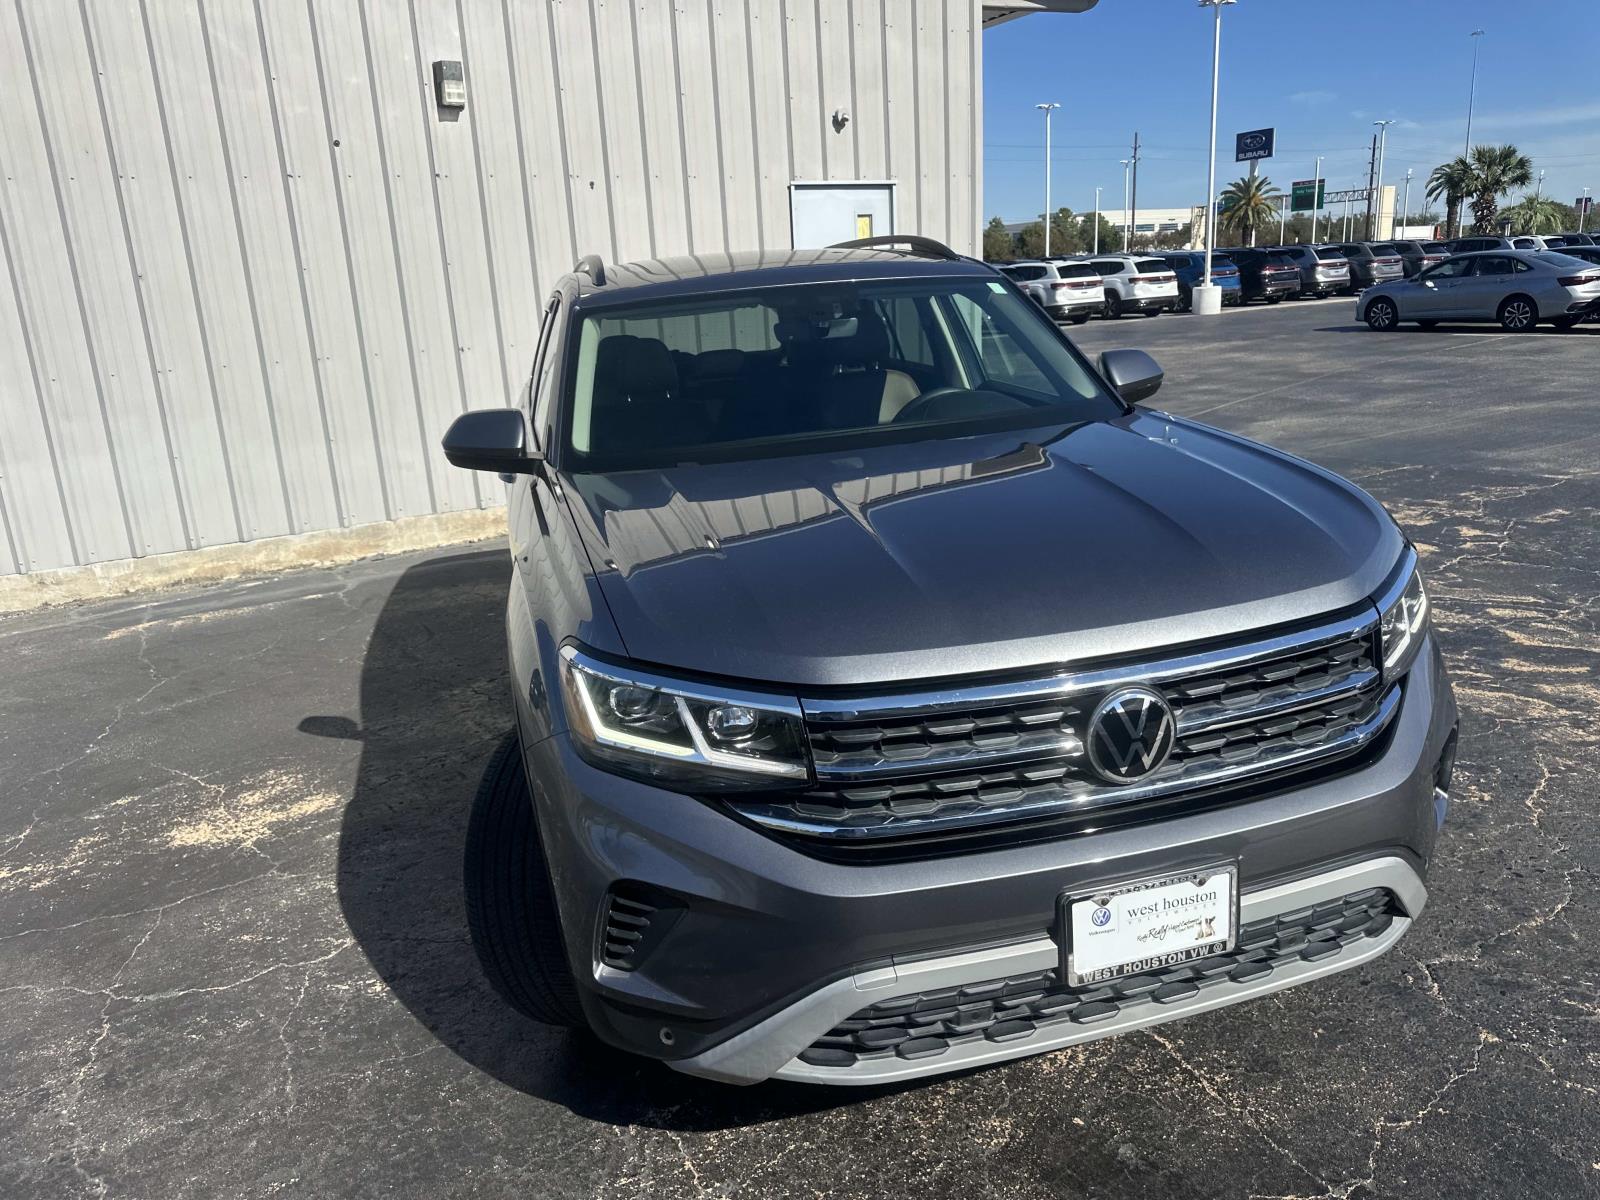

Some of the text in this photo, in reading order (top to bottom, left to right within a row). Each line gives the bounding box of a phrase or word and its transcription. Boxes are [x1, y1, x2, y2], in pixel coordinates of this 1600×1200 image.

[1238, 150, 1268, 160] SUBARU
[1128, 891, 1217, 918] west houston
[1082, 945, 1210, 983] WEST HOUSTON VW
